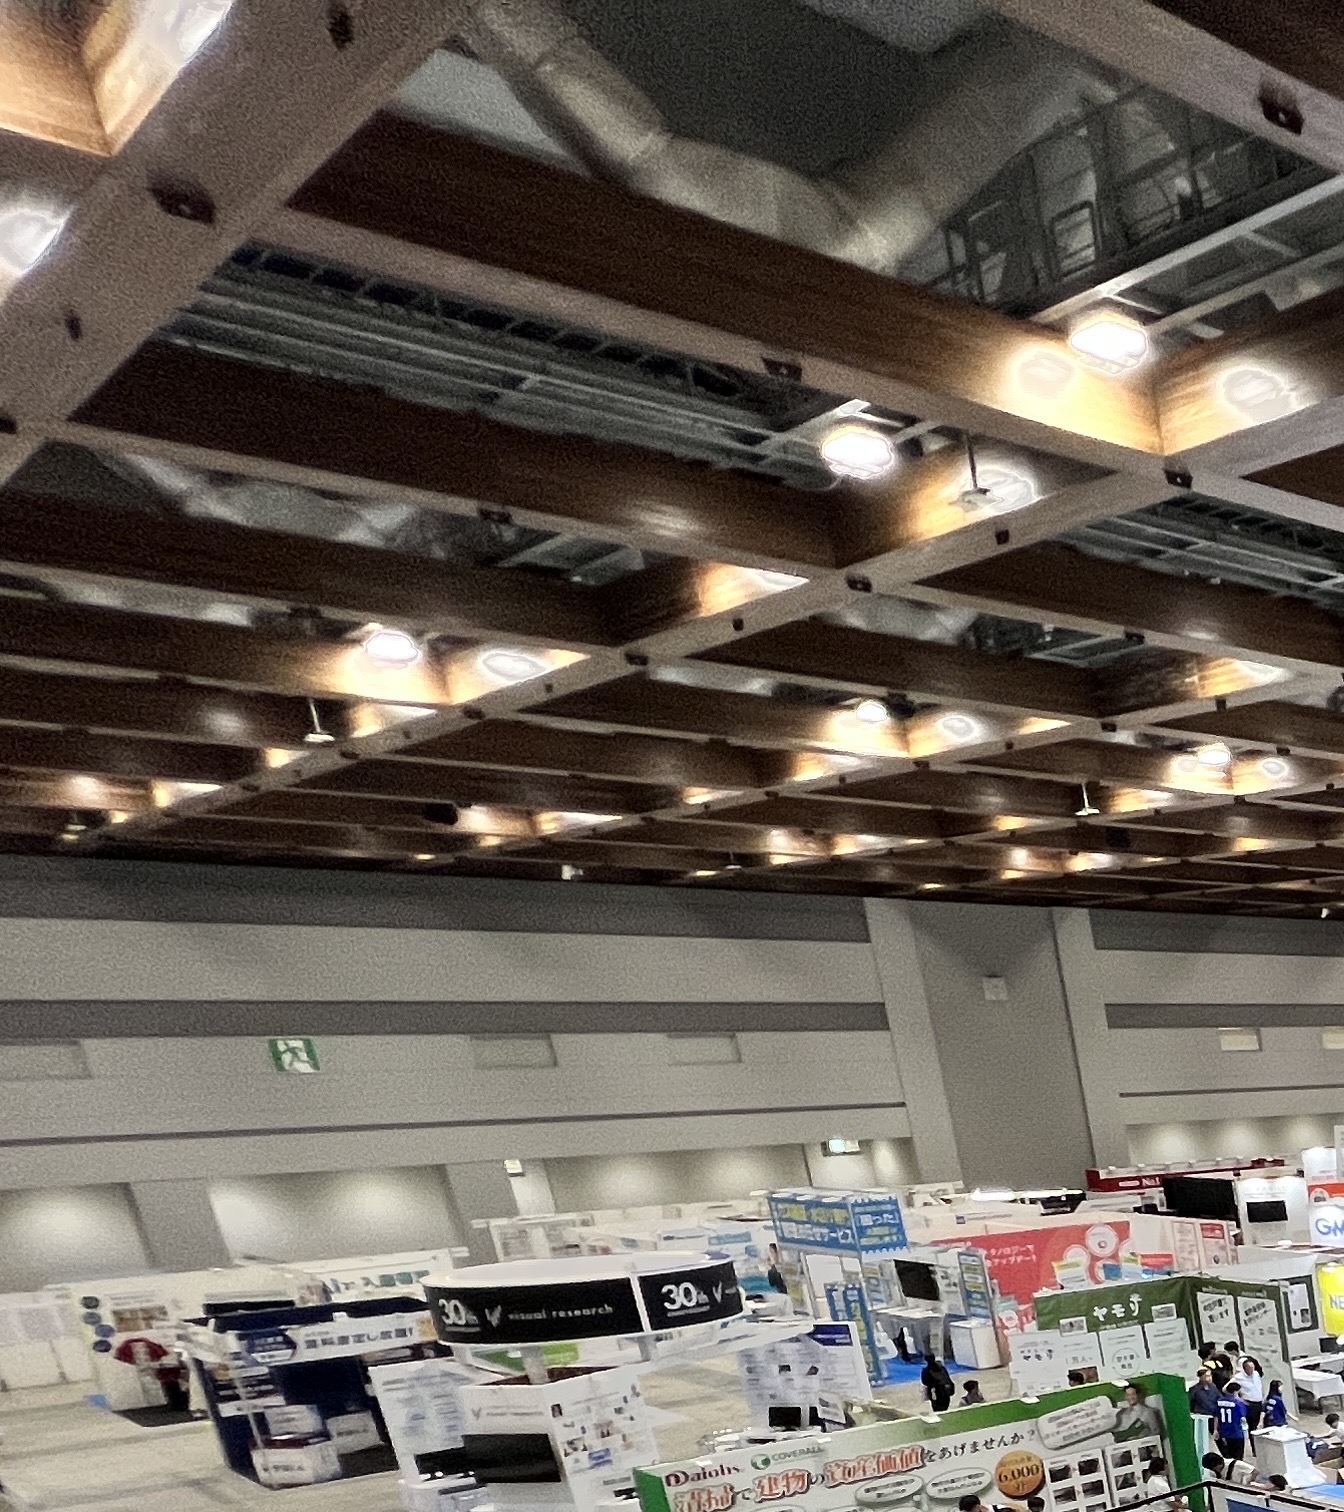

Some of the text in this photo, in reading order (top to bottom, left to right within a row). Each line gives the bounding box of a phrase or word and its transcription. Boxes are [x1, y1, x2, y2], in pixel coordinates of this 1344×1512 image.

[552, 1303, 614, 1319] research
[1220, 1407, 1232, 1424] 11
[998, 1463, 1040, 1484] 6,000
